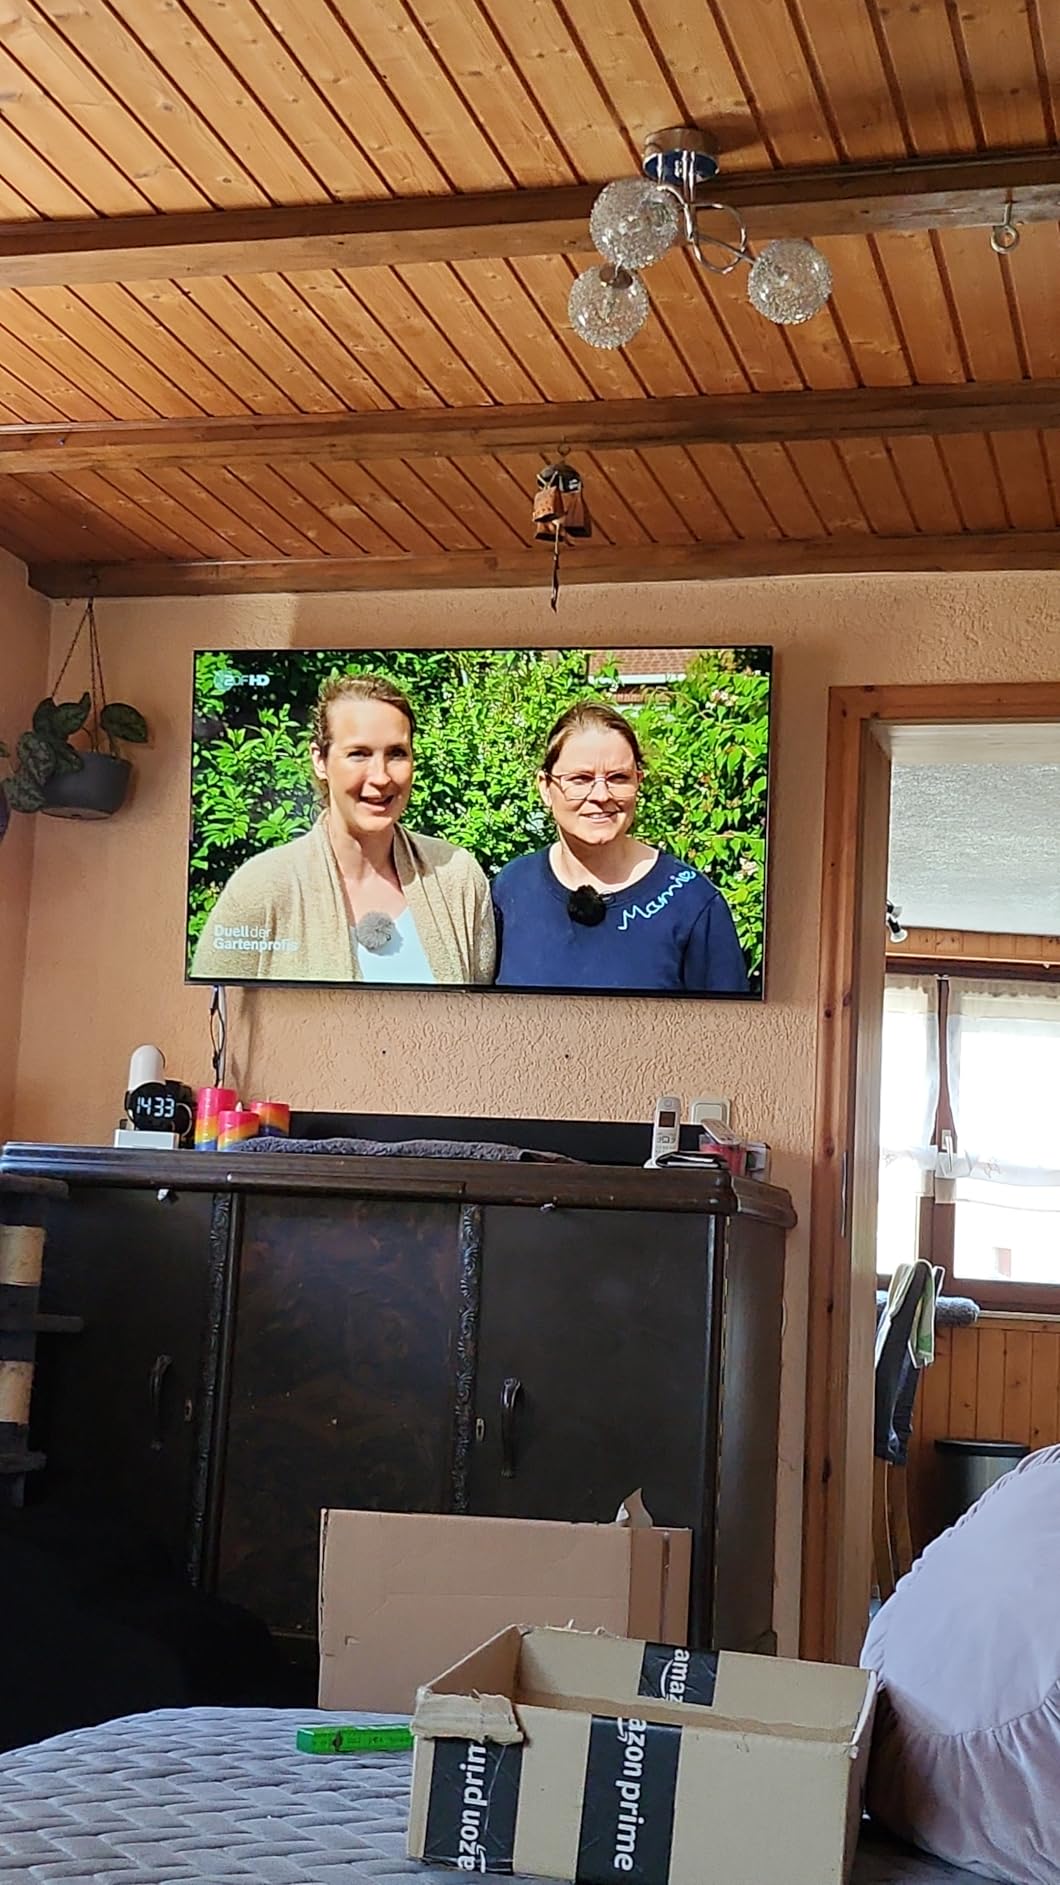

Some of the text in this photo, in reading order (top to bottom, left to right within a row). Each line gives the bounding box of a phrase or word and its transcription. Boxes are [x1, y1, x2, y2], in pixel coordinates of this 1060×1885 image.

[213, 937, 299, 952] Gartenprofis
[214, 924, 272, 938] Duell der
[669, 1648, 690, 1702] amaz
[614, 1718, 647, 1872] azon prime
[457, 1809, 481, 1871] azon
